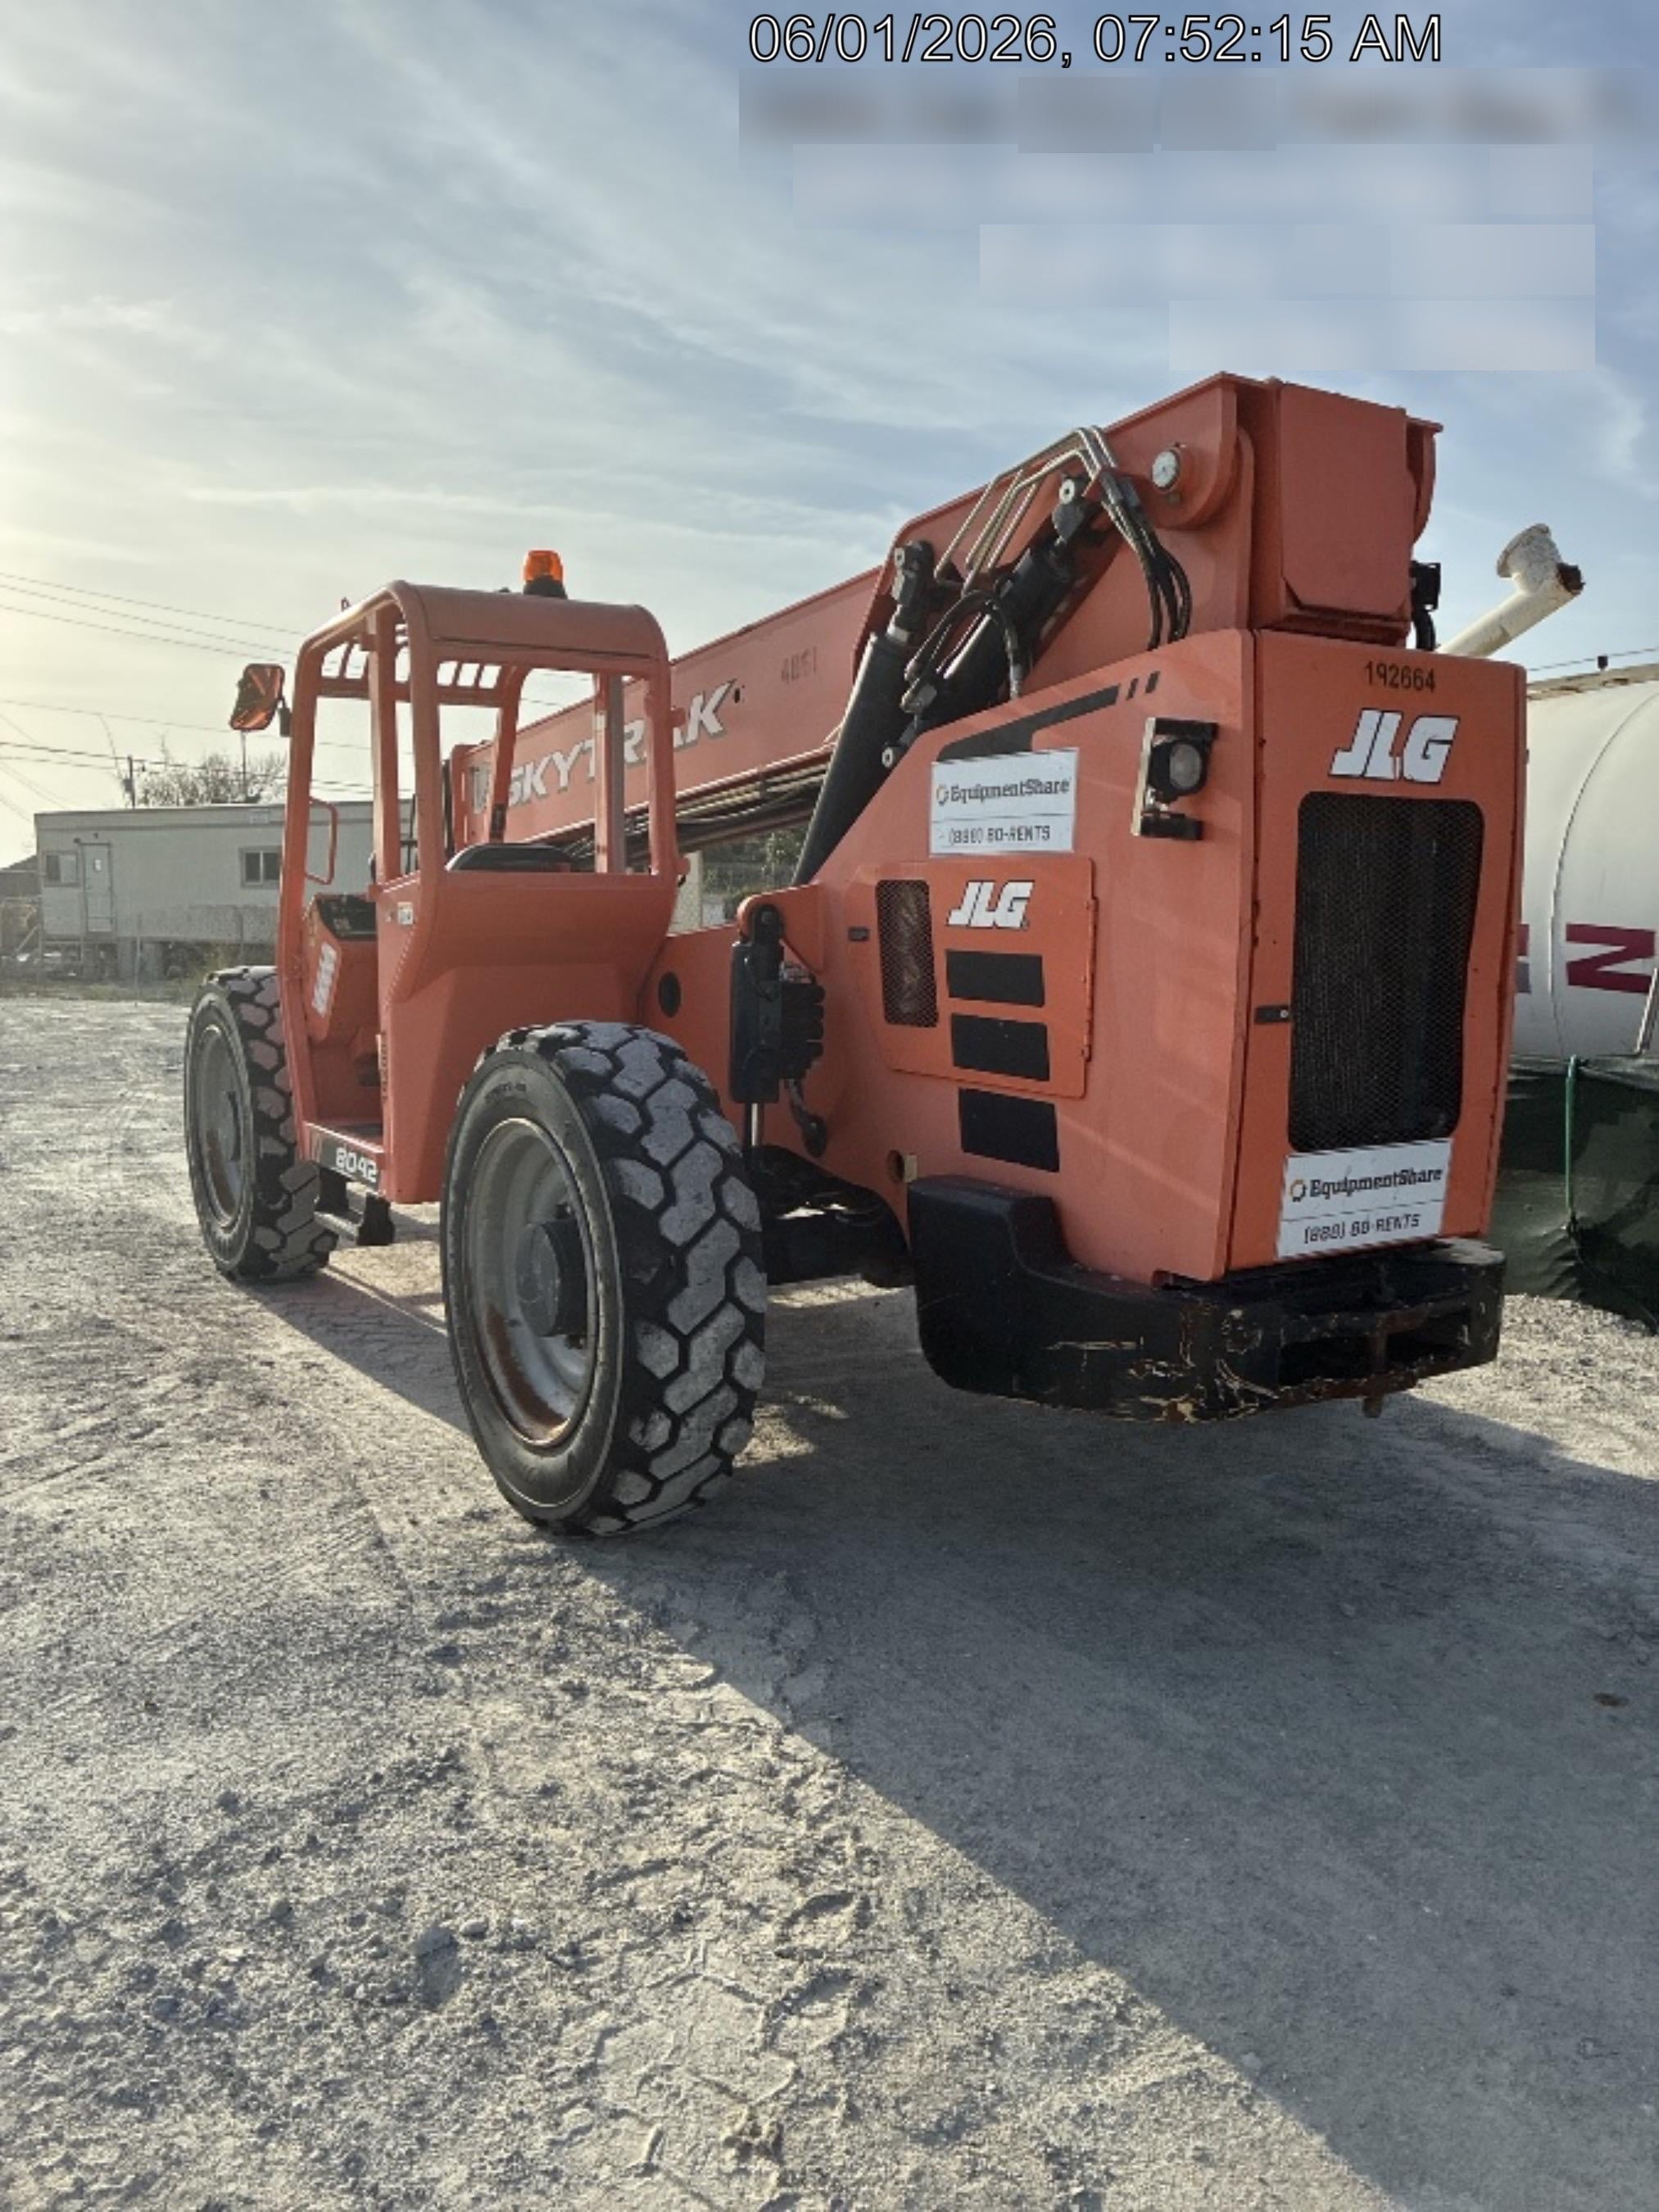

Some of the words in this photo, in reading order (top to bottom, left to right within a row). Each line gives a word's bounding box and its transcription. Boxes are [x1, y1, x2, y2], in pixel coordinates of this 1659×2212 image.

[1364, 660, 1436, 692] 192664
[509, 678, 737, 807] SKYTRK
[1327, 707, 1462, 785] JLG
[950, 778, 1071, 805] EquipmentShare
[945, 879, 1036, 929] JLG
[336, 1147, 378, 1183] 8042
[1309, 1167, 1444, 1200] EquipmentShare
